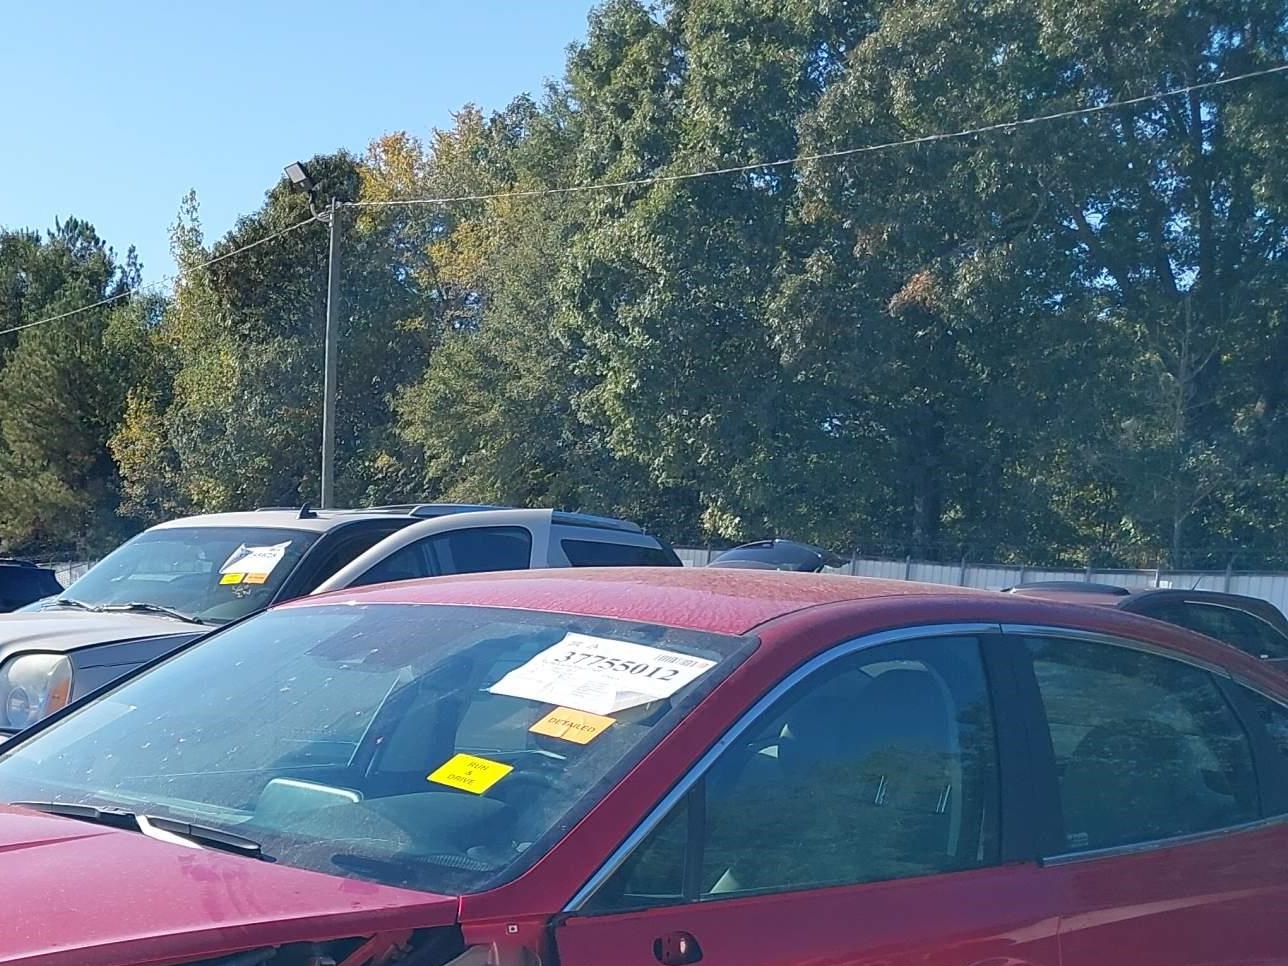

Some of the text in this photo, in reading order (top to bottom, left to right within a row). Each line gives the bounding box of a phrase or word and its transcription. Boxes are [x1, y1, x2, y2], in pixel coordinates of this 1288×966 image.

[554, 651, 680, 681] 37755012
[548, 717, 596, 733] DETAILED
[467, 761, 490, 771] RUN
[447, 774, 476, 785] DRIVE
